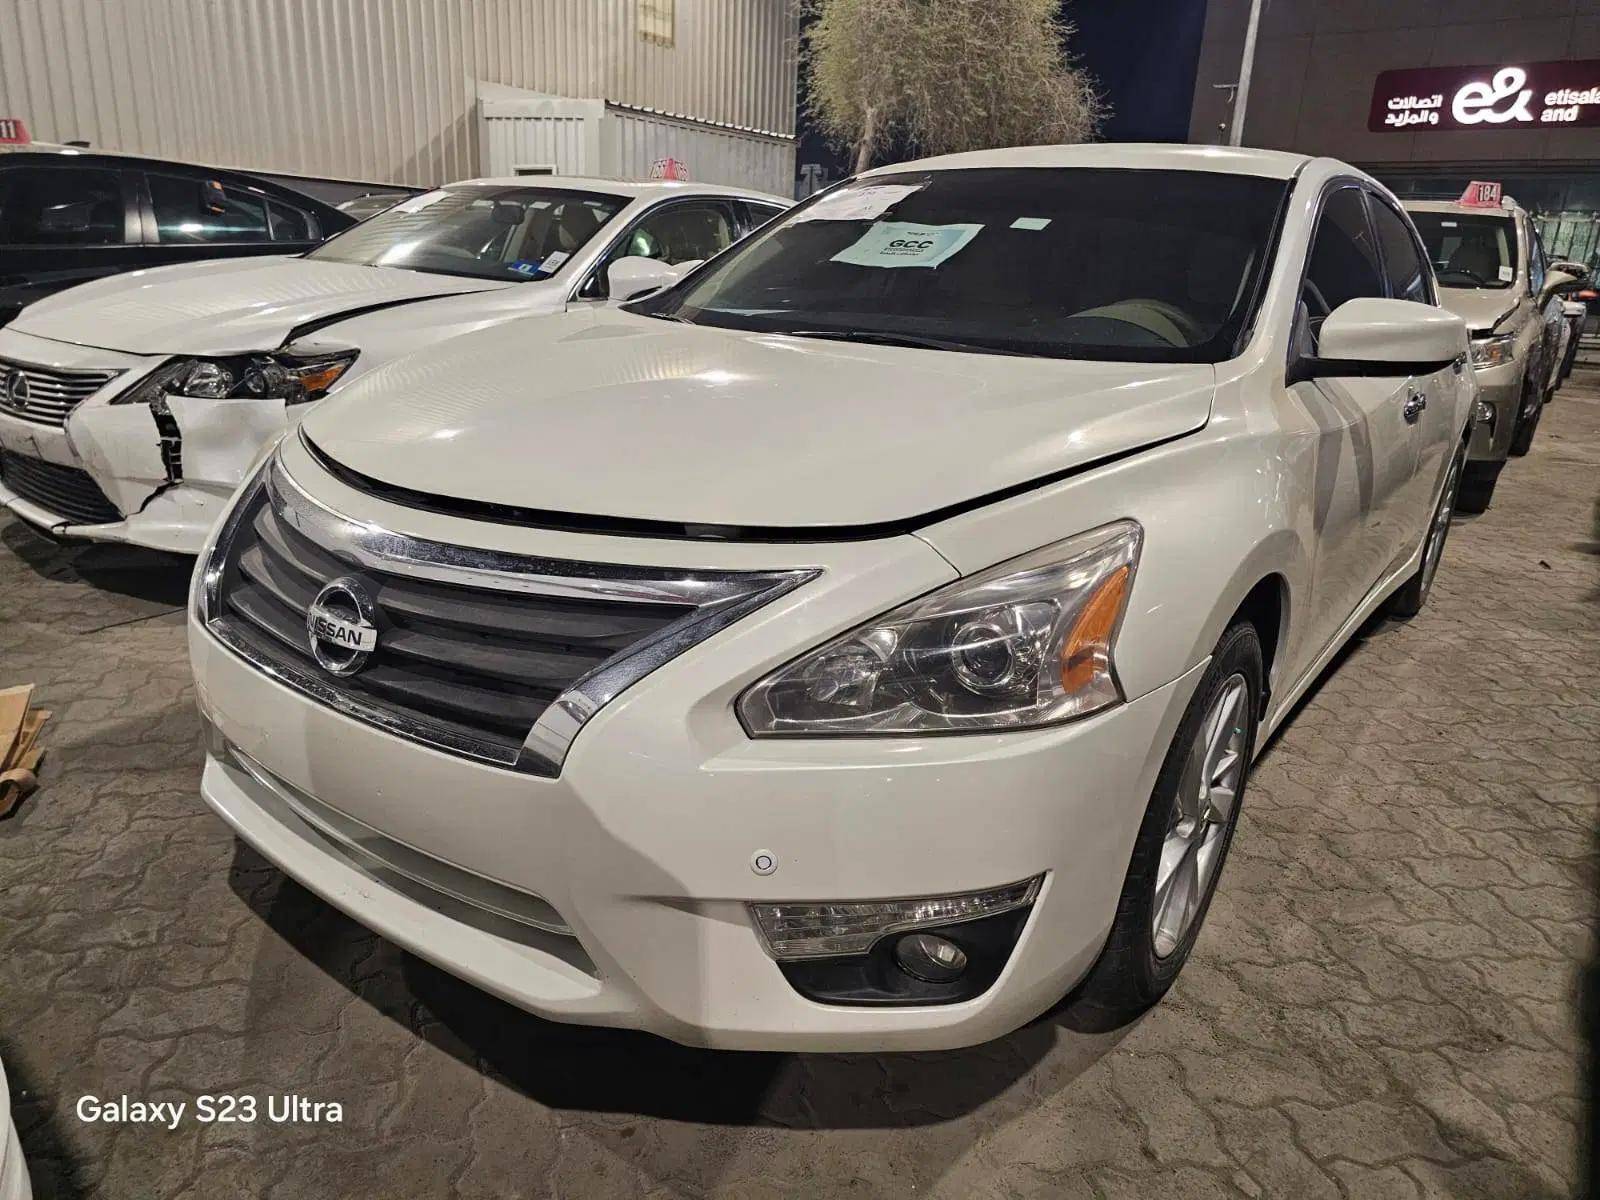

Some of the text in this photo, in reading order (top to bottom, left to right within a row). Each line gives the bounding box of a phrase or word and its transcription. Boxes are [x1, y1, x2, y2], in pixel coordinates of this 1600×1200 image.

[1387, 94, 1443, 110] اتصالات
[1384, 109, 1440, 127] والمزيد
[1540, 104, 1579, 122] and
[1479, 184, 1498, 202] 184
[889, 239, 934, 249] GCC
